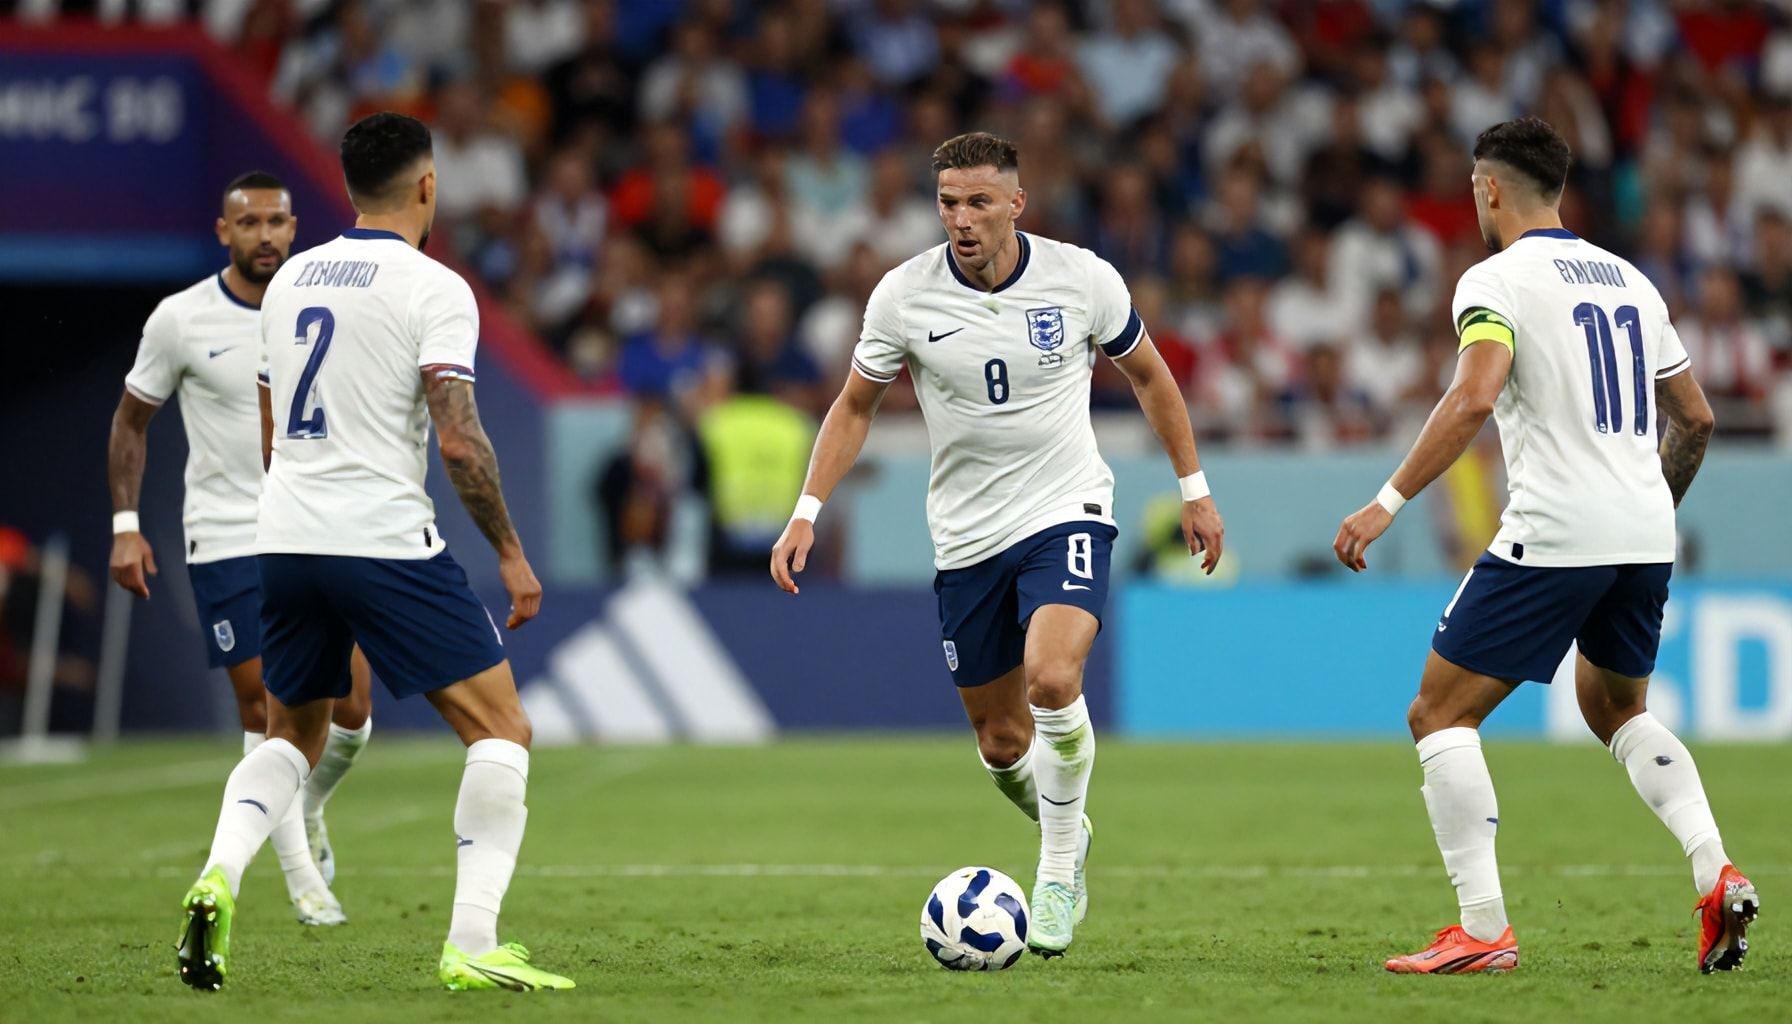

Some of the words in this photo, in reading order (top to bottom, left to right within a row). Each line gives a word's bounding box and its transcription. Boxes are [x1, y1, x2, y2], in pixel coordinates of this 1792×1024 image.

[287, 306, 335, 439] 2
[984, 358, 1010, 404] 8
[1572, 302, 1648, 436] 11
[1067, 532, 1093, 580] 8
